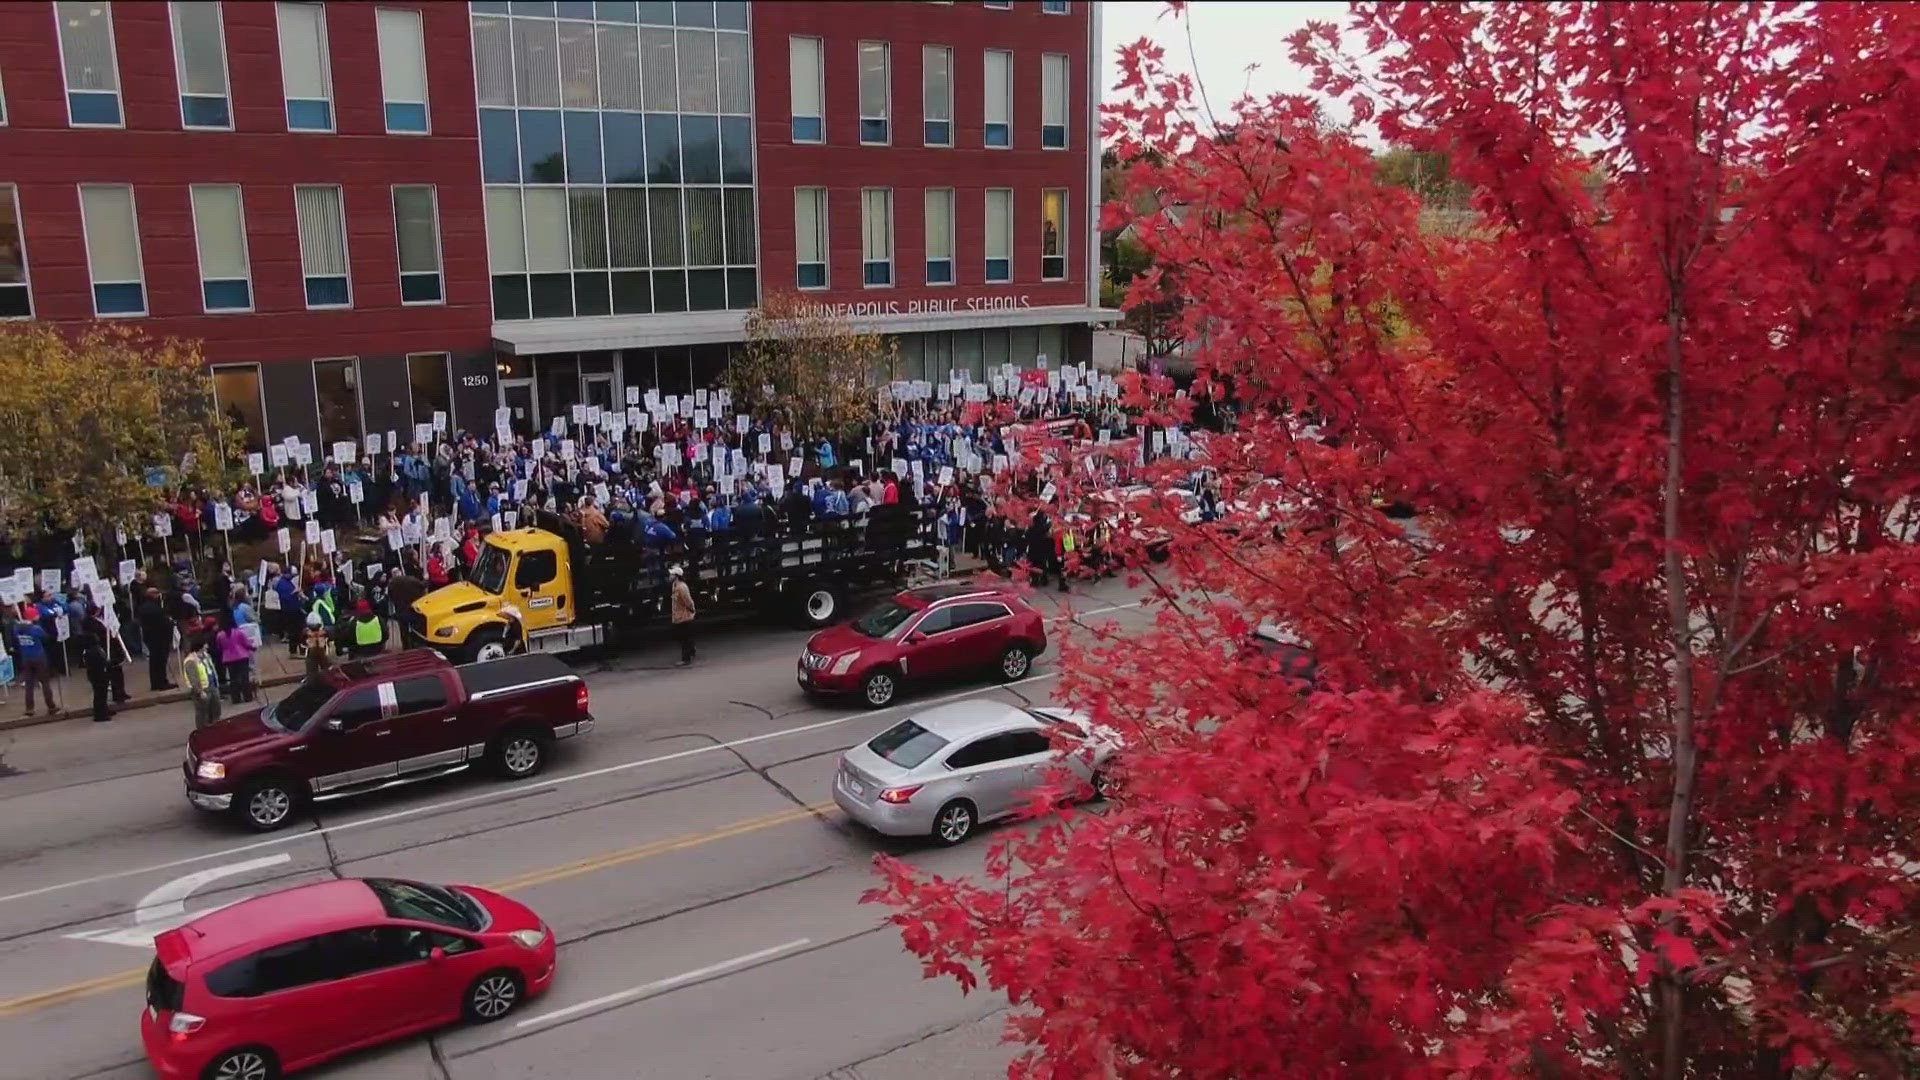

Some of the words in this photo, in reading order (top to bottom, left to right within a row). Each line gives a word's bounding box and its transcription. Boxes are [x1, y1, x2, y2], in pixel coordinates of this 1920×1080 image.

[794, 301, 899, 321] MINNEAPOLIS
[908, 298, 958, 314] PUBLIC
[966, 295, 1030, 312] SCHOOLS
[462, 374, 488, 386] 1250
